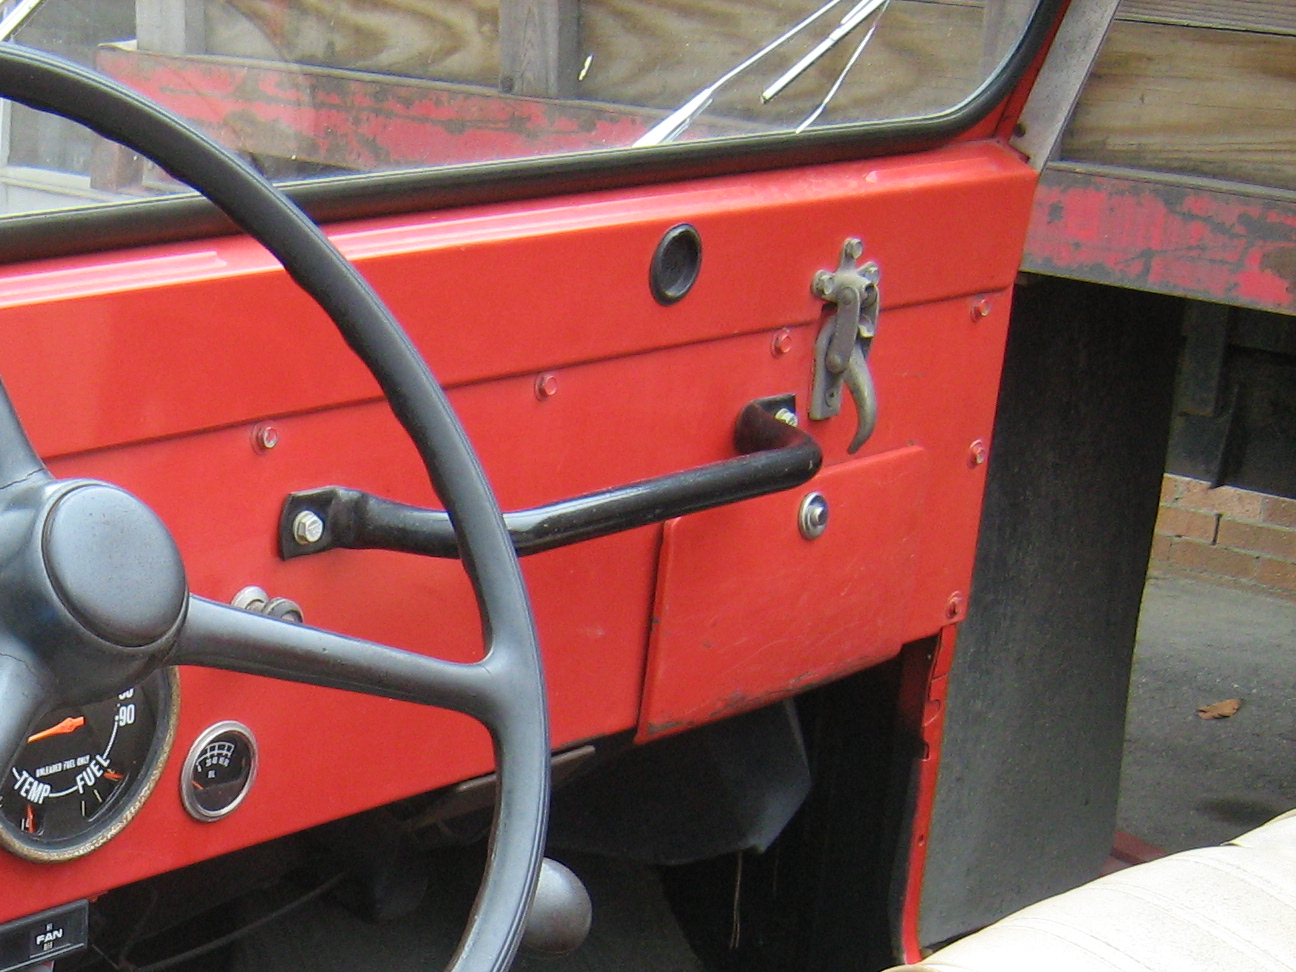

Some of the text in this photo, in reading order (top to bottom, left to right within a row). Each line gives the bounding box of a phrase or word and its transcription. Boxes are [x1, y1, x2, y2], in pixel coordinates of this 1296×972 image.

[119, 703, 136, 727] 90
[35, 754, 91, 779] UNLEADED FUEL ONLY
[75, 754, 111, 795] FUEL
[13, 770, 52, 805] TEMP
[35, 928, 63, 946] FAN
